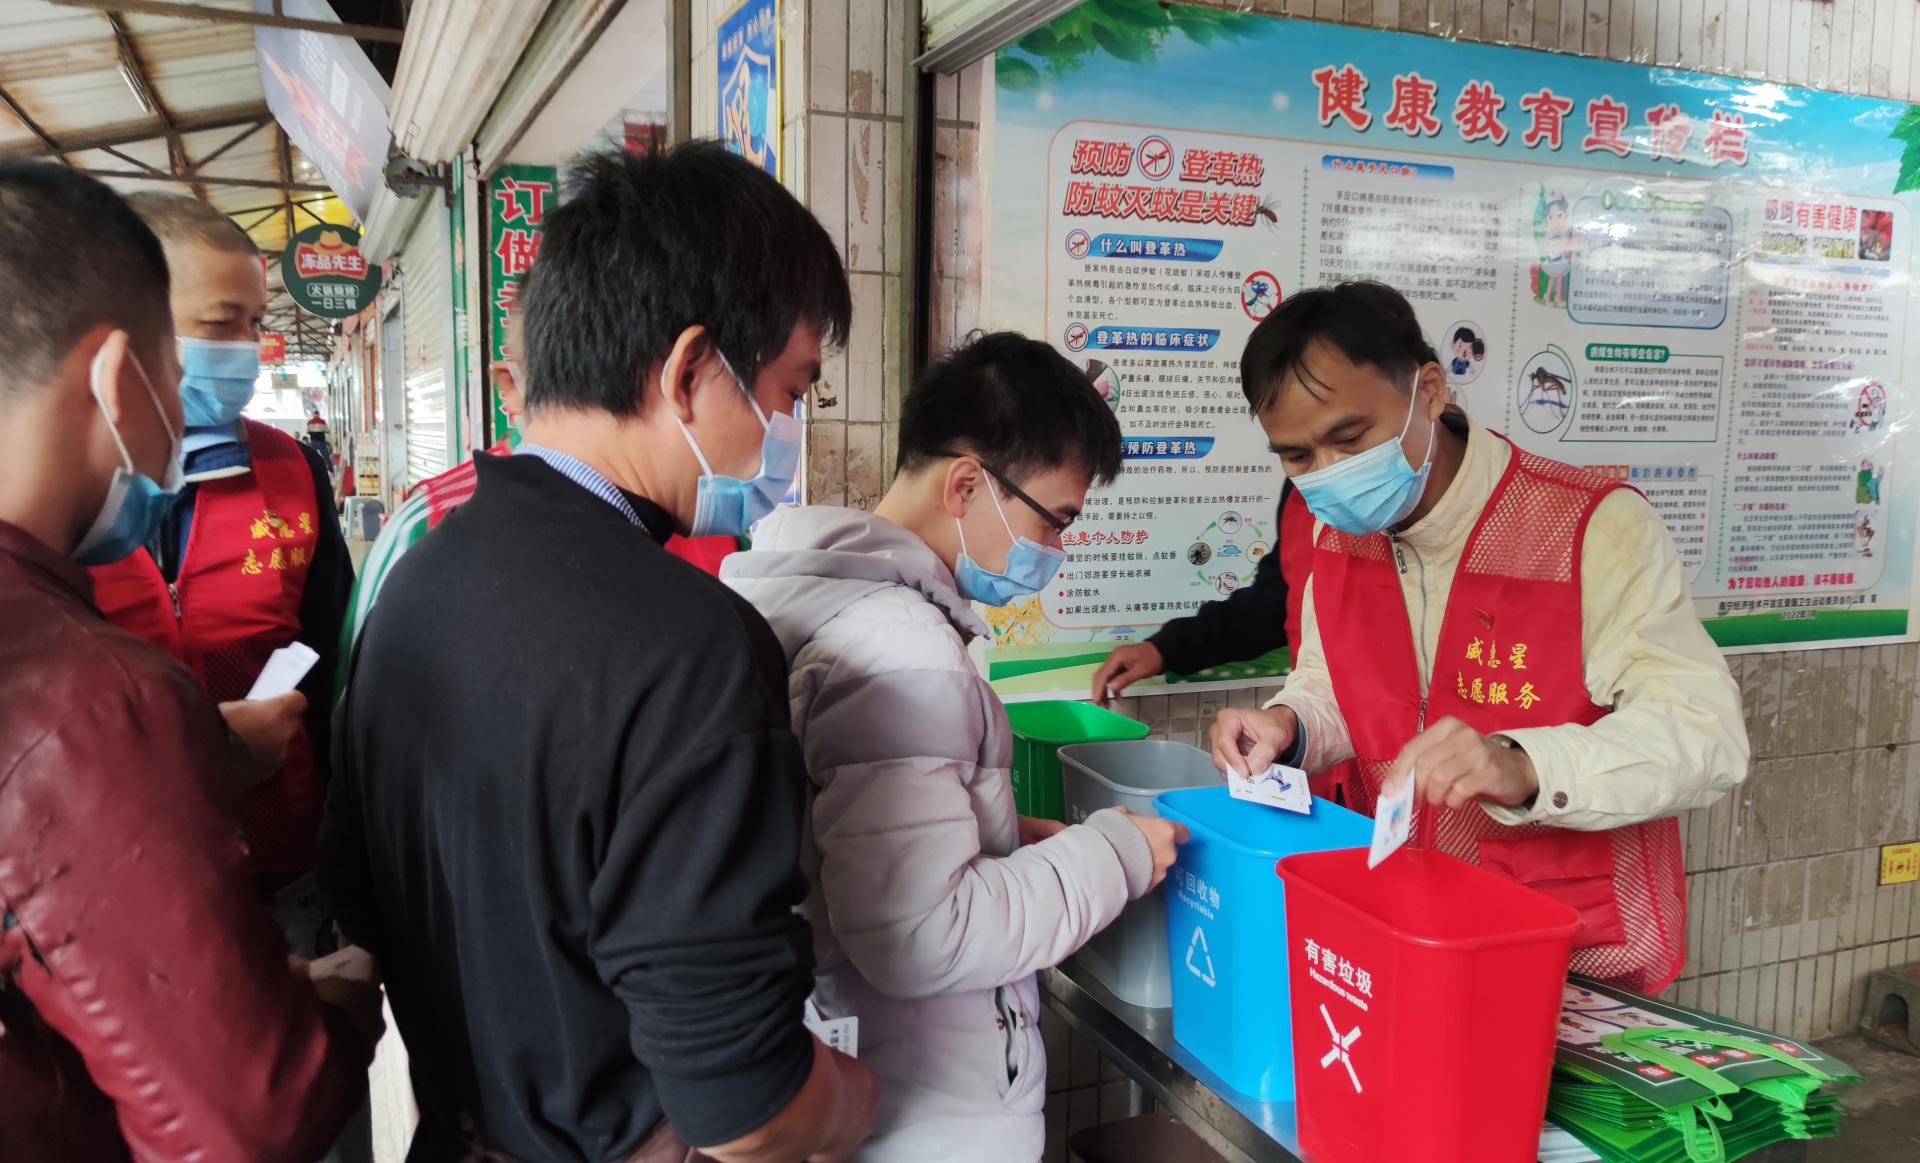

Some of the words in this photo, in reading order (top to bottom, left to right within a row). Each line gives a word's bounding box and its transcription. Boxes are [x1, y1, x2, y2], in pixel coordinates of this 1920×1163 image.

[1312, 63, 1750, 167] 健康教育宣传栏
[1071, 140, 1134, 175] 预防
[1179, 149, 1263, 187] 登革热
[1063, 180, 1259, 227] 防蚊灭蚊是关键
[1764, 199, 1858, 232] 吸烟有害健康
[301, 253, 363, 272] 冻品先生
[1101, 237, 1187, 257] 什么叫登革热
[311, 298, 357, 310] 一日三餐
[1096, 330, 1210, 347] 登革热的临床症状
[1457, 671, 1542, 710] 志愿服务
[1304, 937, 1373, 999] 有害垃圾
